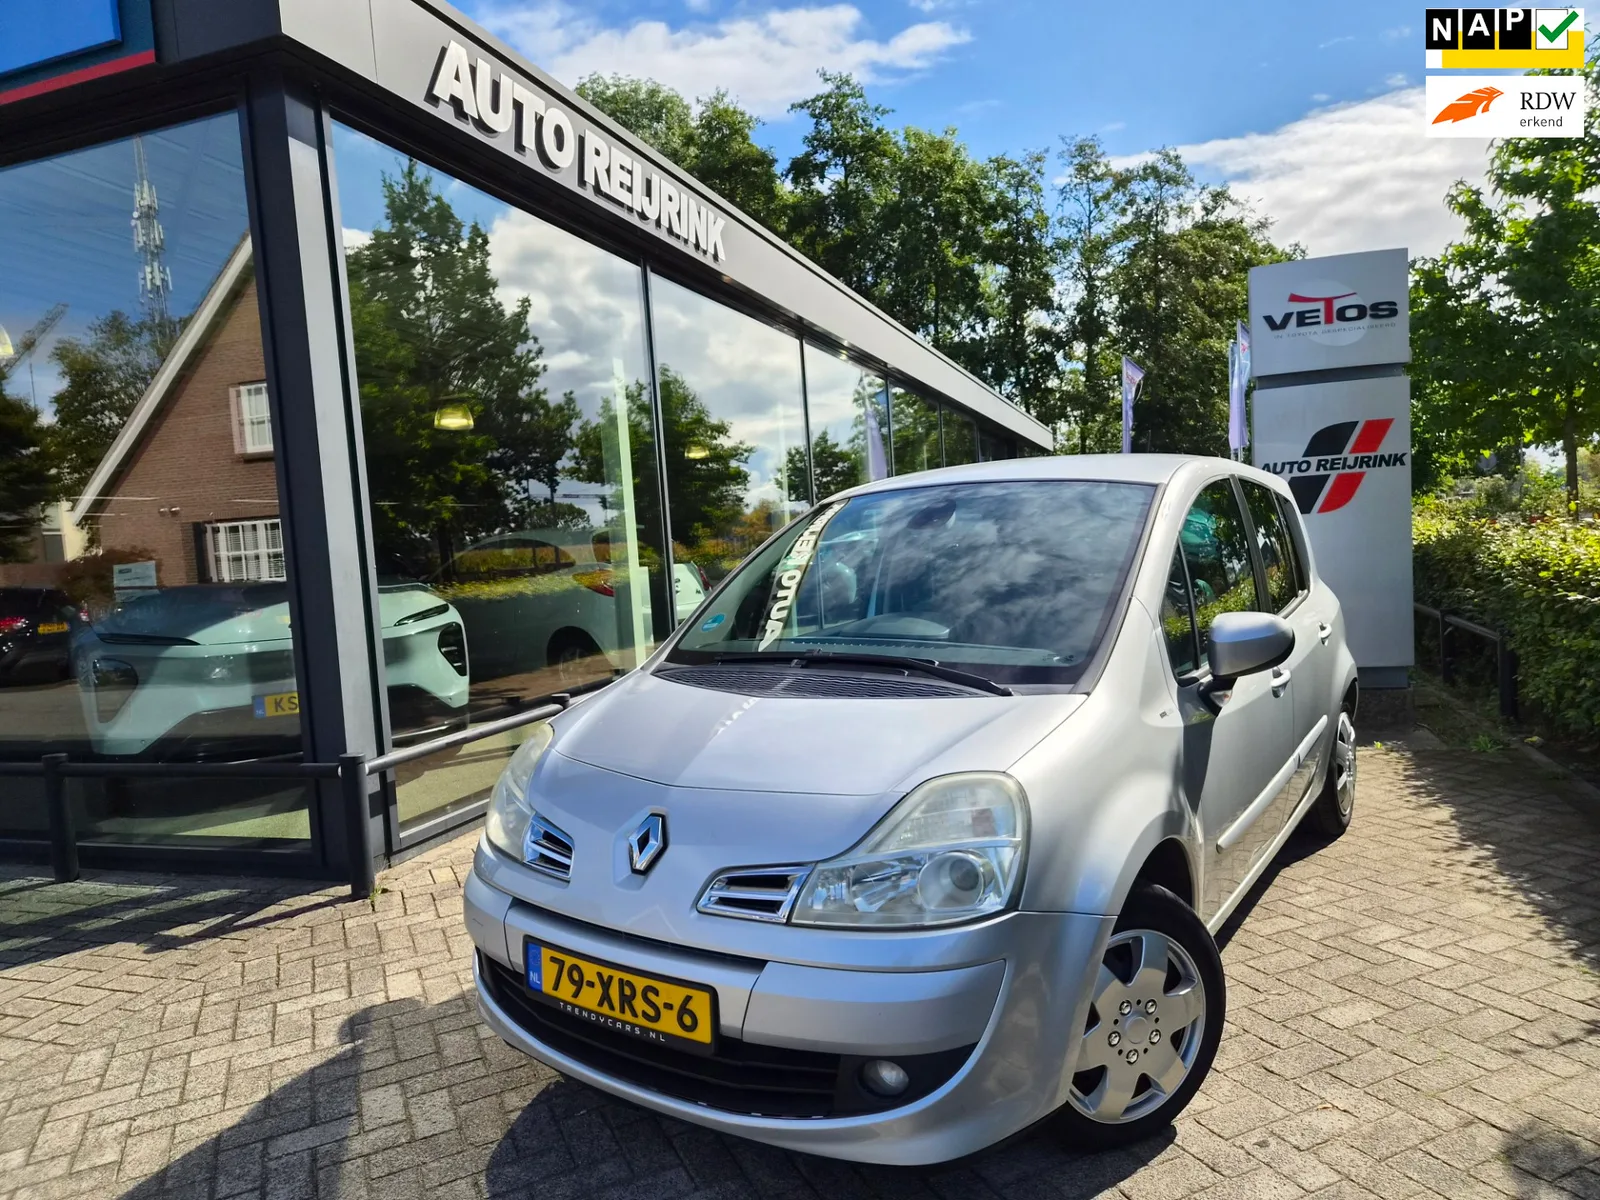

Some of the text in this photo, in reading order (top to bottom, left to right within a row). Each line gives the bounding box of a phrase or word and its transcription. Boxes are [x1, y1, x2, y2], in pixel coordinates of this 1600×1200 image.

[431, 39, 727, 262] AUTO REIJRINK
[1286, 330, 1319, 339] TOYOTA
[1261, 452, 1408, 475] AUTO REIJRINK
[529, 971, 541, 985] NL
[549, 955, 699, 1034] 79-XRS-6
[559, 1001, 666, 1043] TRENDYCARS.NL
